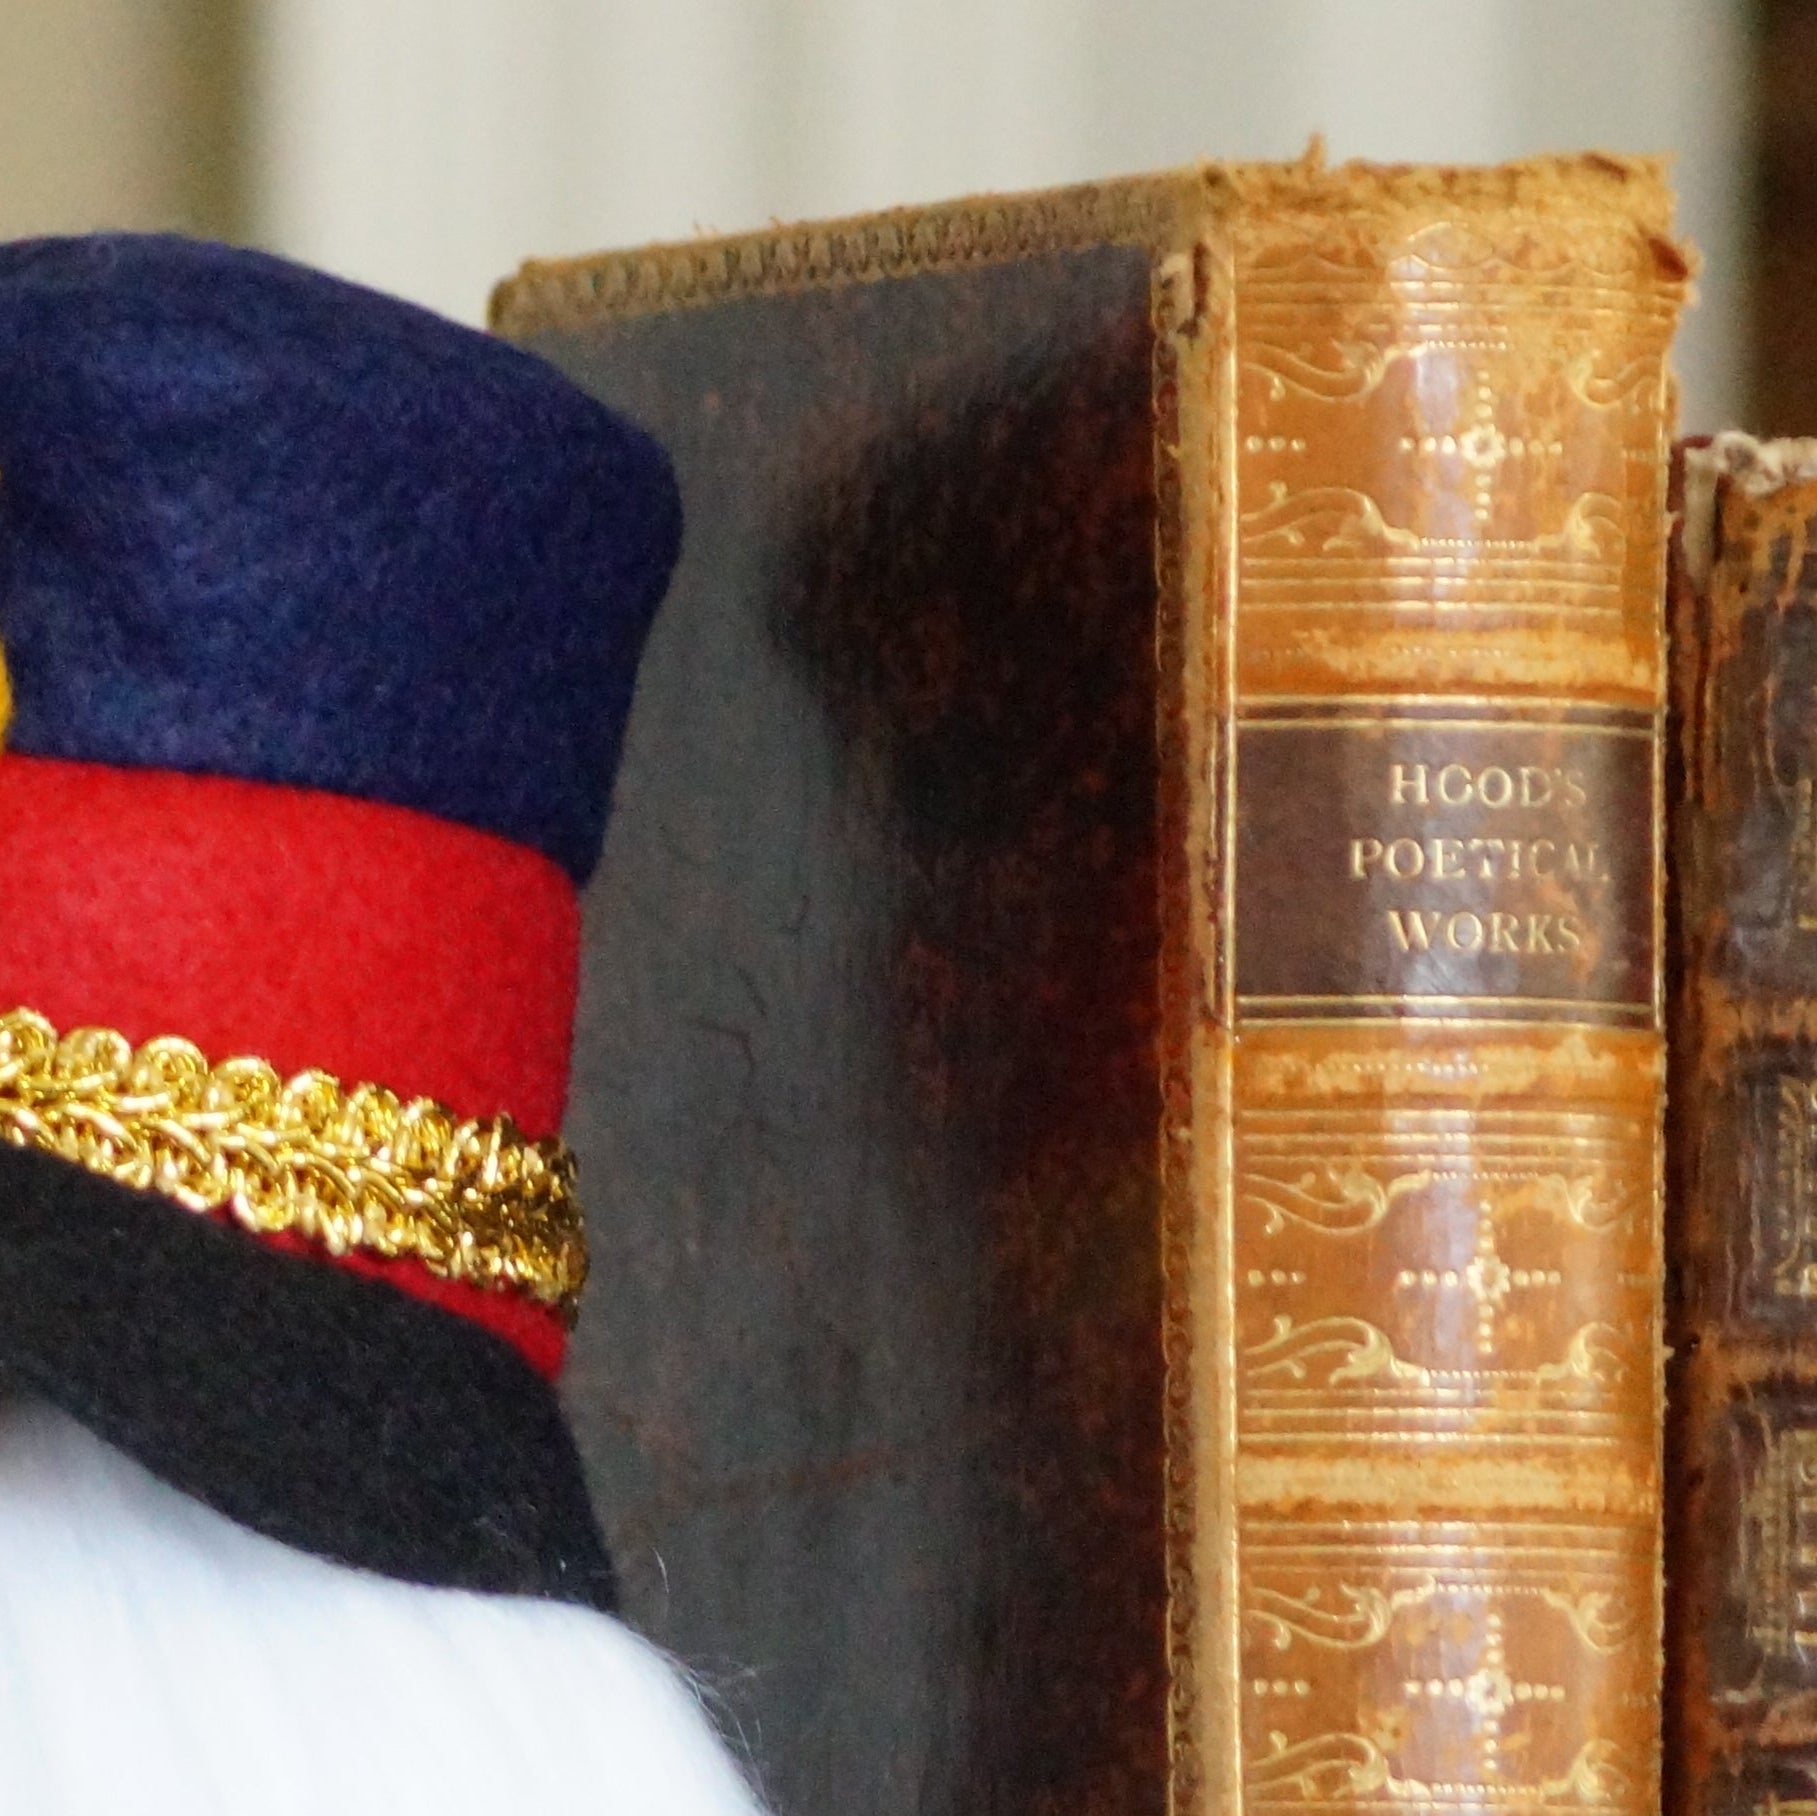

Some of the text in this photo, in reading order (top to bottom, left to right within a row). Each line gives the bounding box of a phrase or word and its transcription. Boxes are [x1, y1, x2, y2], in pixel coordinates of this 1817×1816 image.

[1388, 763, 1587, 808] HOOD'S
[1349, 836, 1609, 881] POETICAL
[1386, 909, 1581, 955] WORKS
